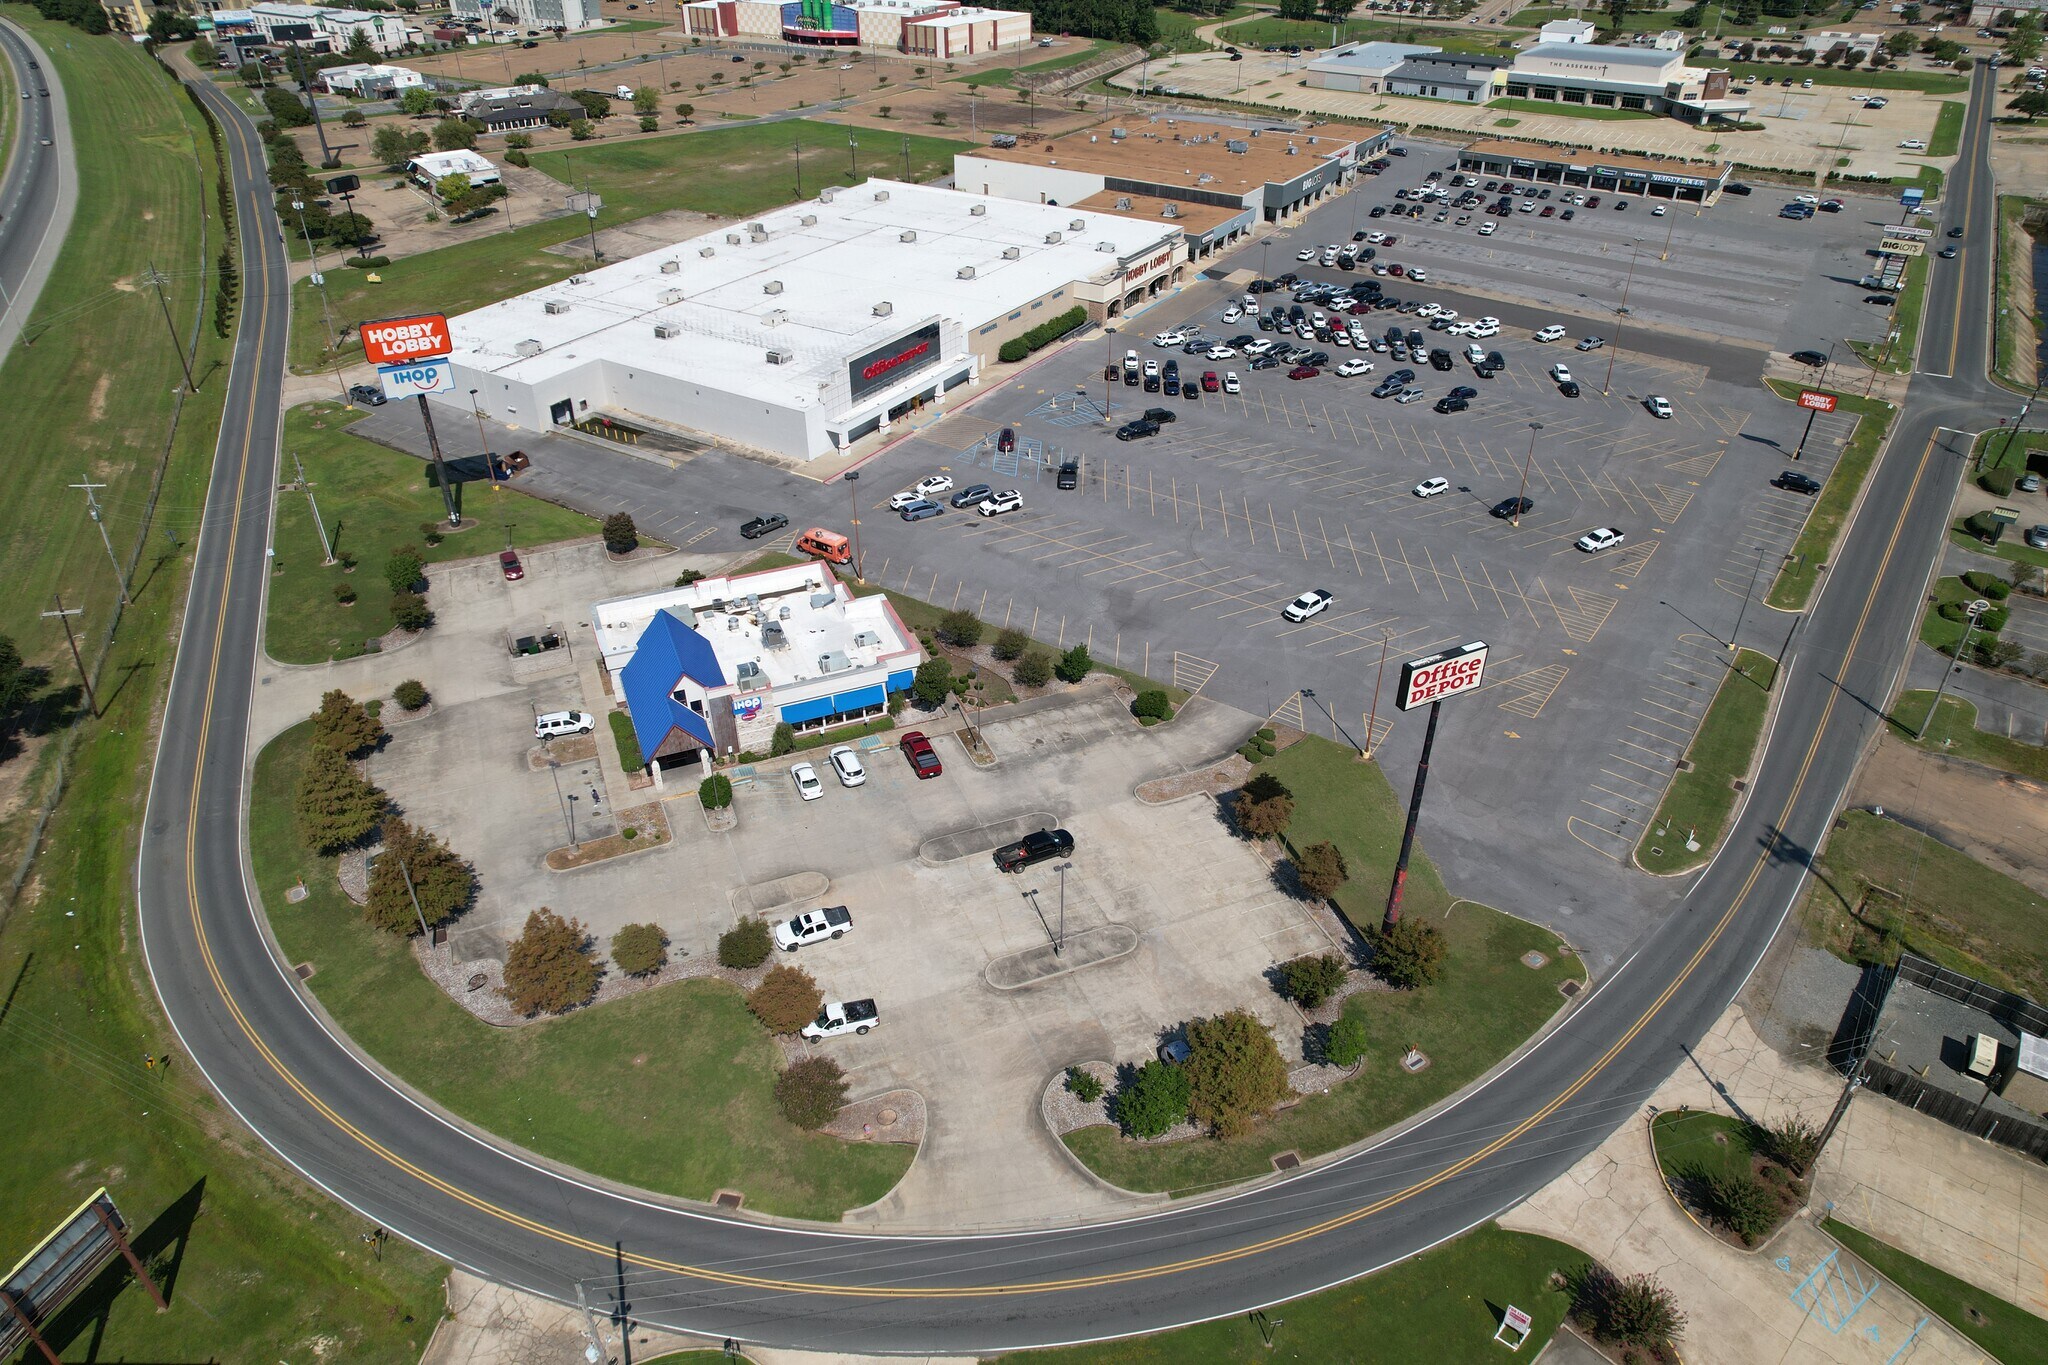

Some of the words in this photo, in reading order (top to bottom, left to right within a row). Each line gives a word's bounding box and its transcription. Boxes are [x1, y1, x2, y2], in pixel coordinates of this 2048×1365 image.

[1125, 261, 1149, 283] HOBBY
[1150, 250, 1171, 270] LOBBY
[368, 322, 434, 344] HOBBY
[381, 335, 443, 356] LOBBY
[393, 367, 438, 385] IHOP
[1802, 393, 1832, 403] HOBBY
[1804, 400, 1832, 410] LOBBY
[1412, 658, 1482, 689] Office
[1410, 672, 1478, 704] DEPOT
[733, 697, 760, 710] IHOP
